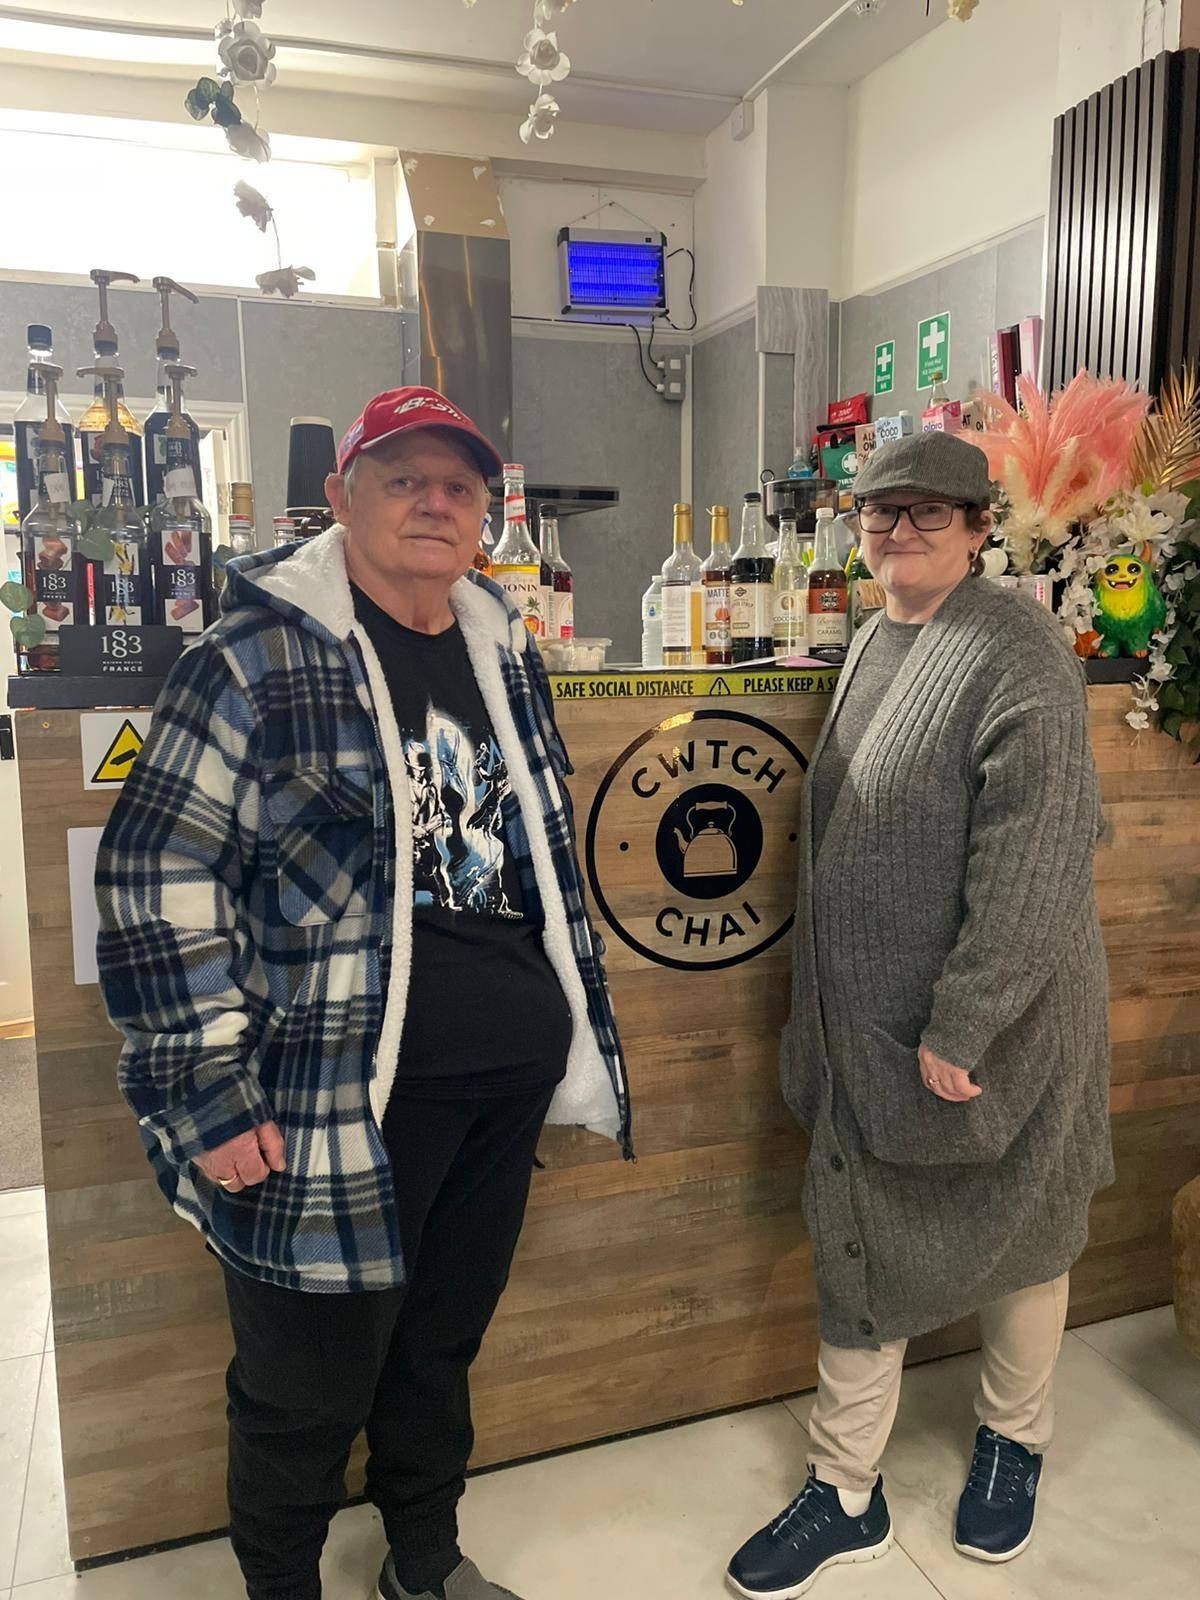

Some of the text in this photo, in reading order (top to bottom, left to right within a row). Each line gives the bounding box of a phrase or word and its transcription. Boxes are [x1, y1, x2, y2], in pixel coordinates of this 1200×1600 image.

[880, 426, 898, 438] COCO
[102, 665, 144, 673] FRANCE
[556, 681, 586, 698] SAFE
[588, 680, 633, 697] SOCIAL
[636, 679, 694, 696] DISTANCE
[743, 678, 784, 693] PLEASE
[786, 677, 813, 693] KEEP
[816, 676, 825, 691] A
[631, 739, 786, 799] CWTCH
[655, 901, 761, 947] CHAI
